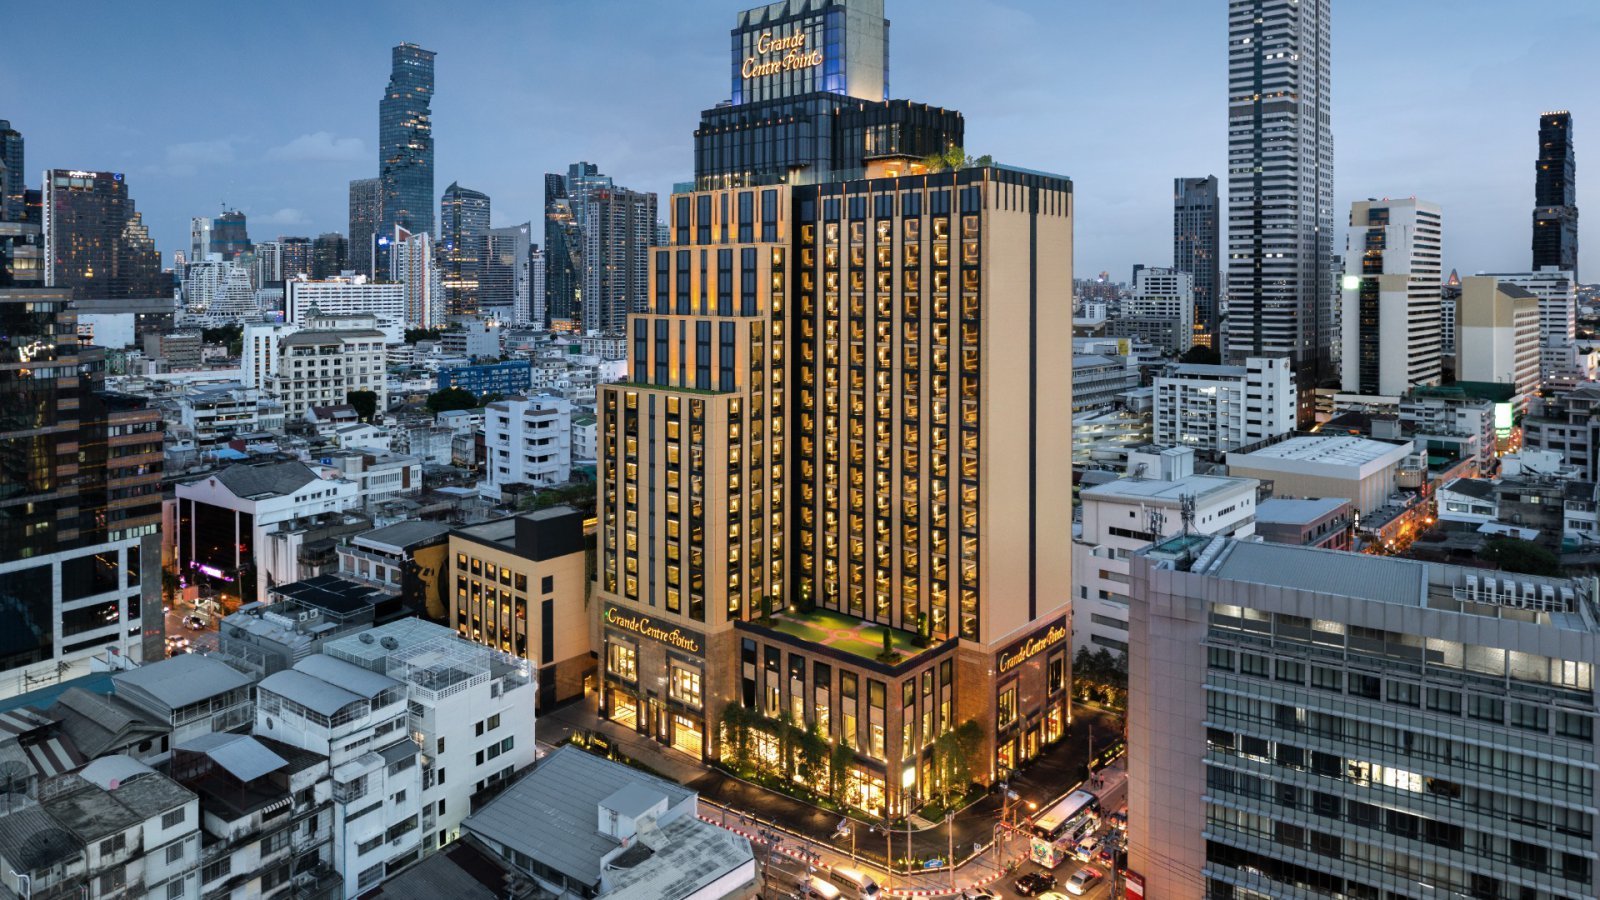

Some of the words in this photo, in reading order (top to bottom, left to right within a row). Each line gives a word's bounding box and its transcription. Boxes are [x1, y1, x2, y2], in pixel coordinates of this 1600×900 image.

[757, 28, 805, 54] Grande
[742, 56, 781, 79] Centre
[782, 48, 823, 71] Point
[608, 607, 640, 632] Grande
[640, 618, 669, 642] Centre
[668, 629, 699, 652] Point
[1000, 646, 1026, 673] Grande
[1025, 637, 1047, 658] Centre
